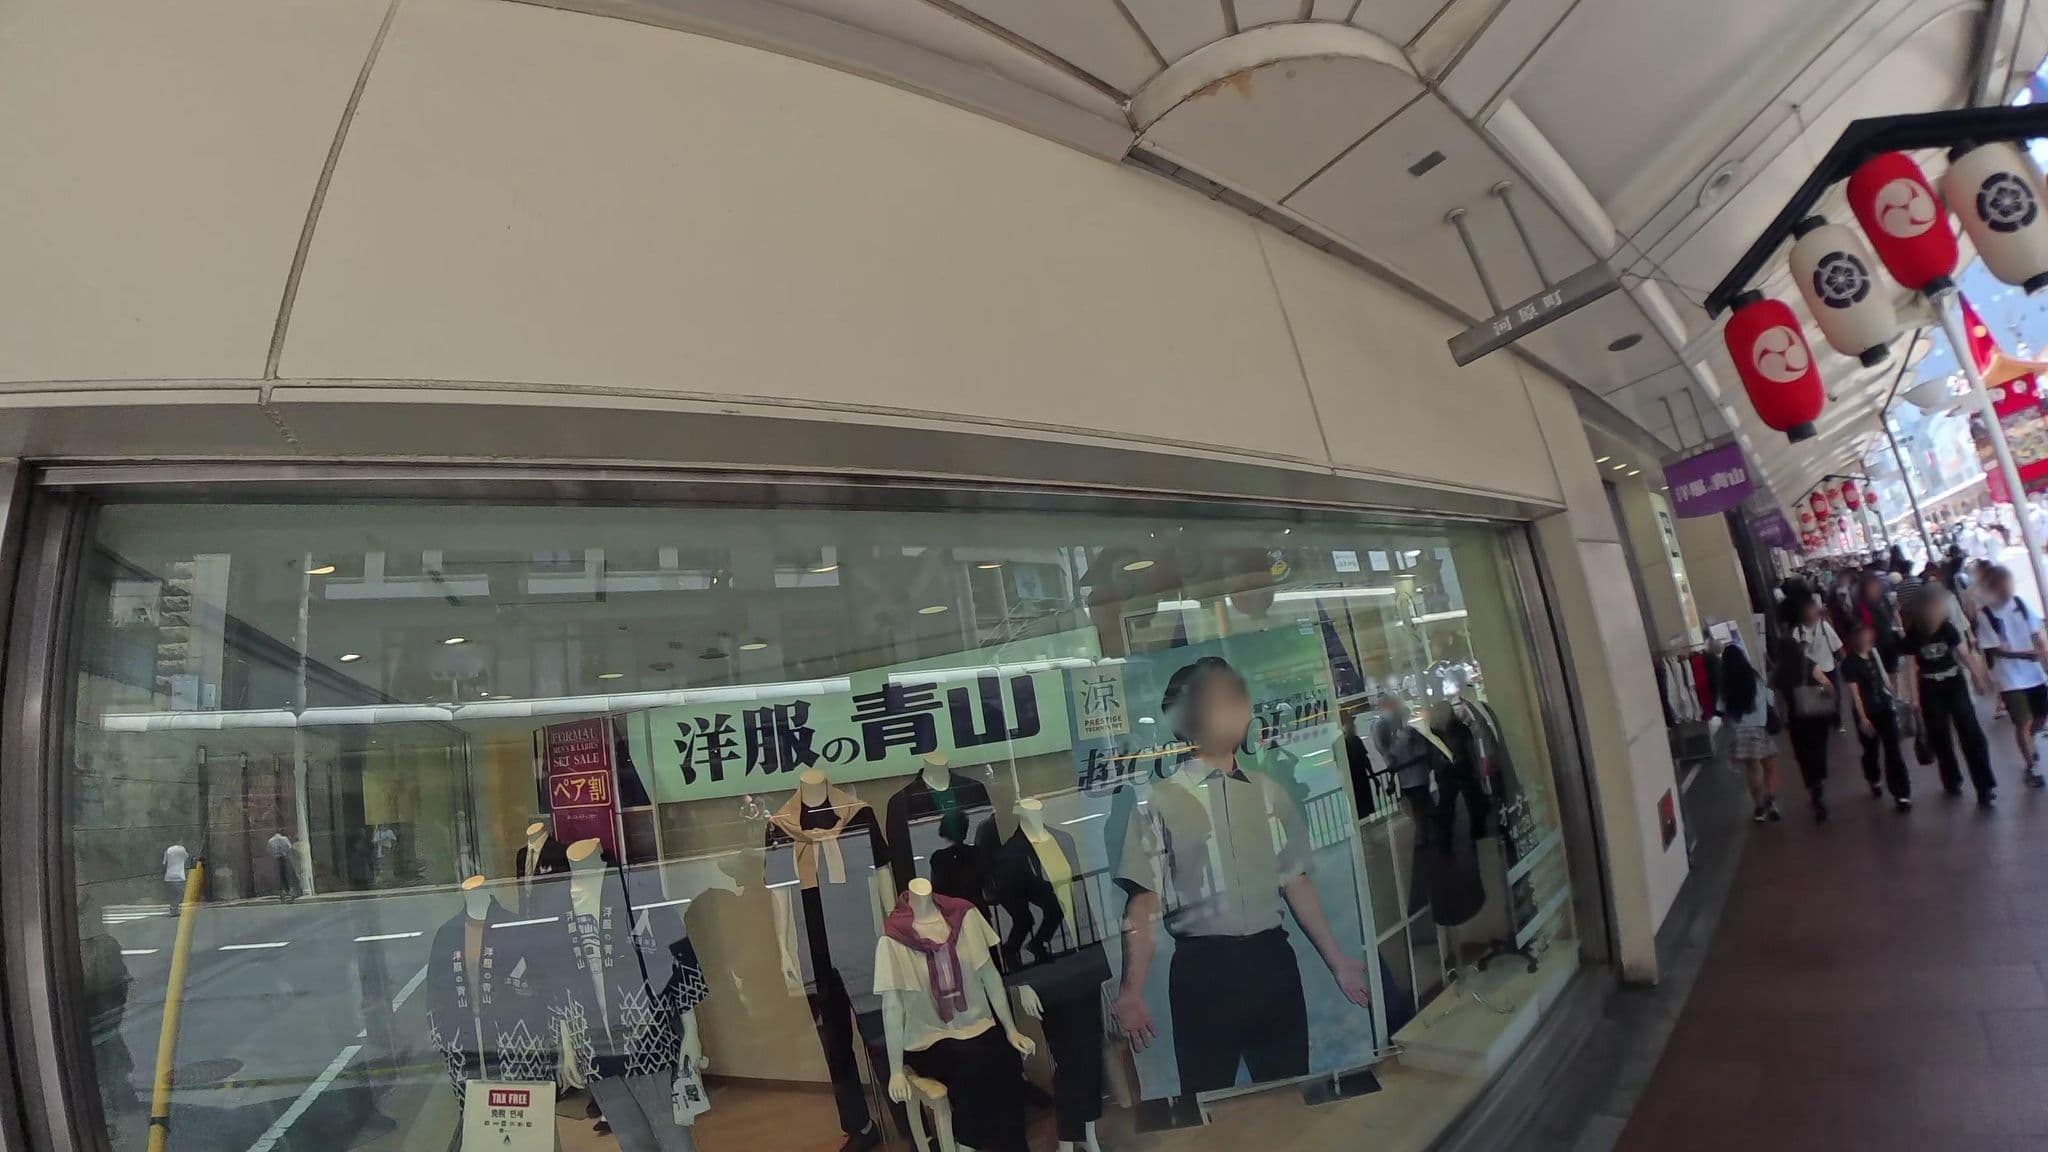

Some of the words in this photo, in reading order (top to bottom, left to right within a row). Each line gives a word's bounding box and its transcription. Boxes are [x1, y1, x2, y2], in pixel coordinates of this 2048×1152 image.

[1080, 675, 1120, 715] 涼
[673, 673, 1041, 786] 洋服の青山
[553, 756, 570, 768] SET
[574, 753, 600, 765] SALE
[554, 775, 606, 801] ペア割
[492, 1093, 507, 1104] TAX
[508, 1093, 528, 1105] FREE
